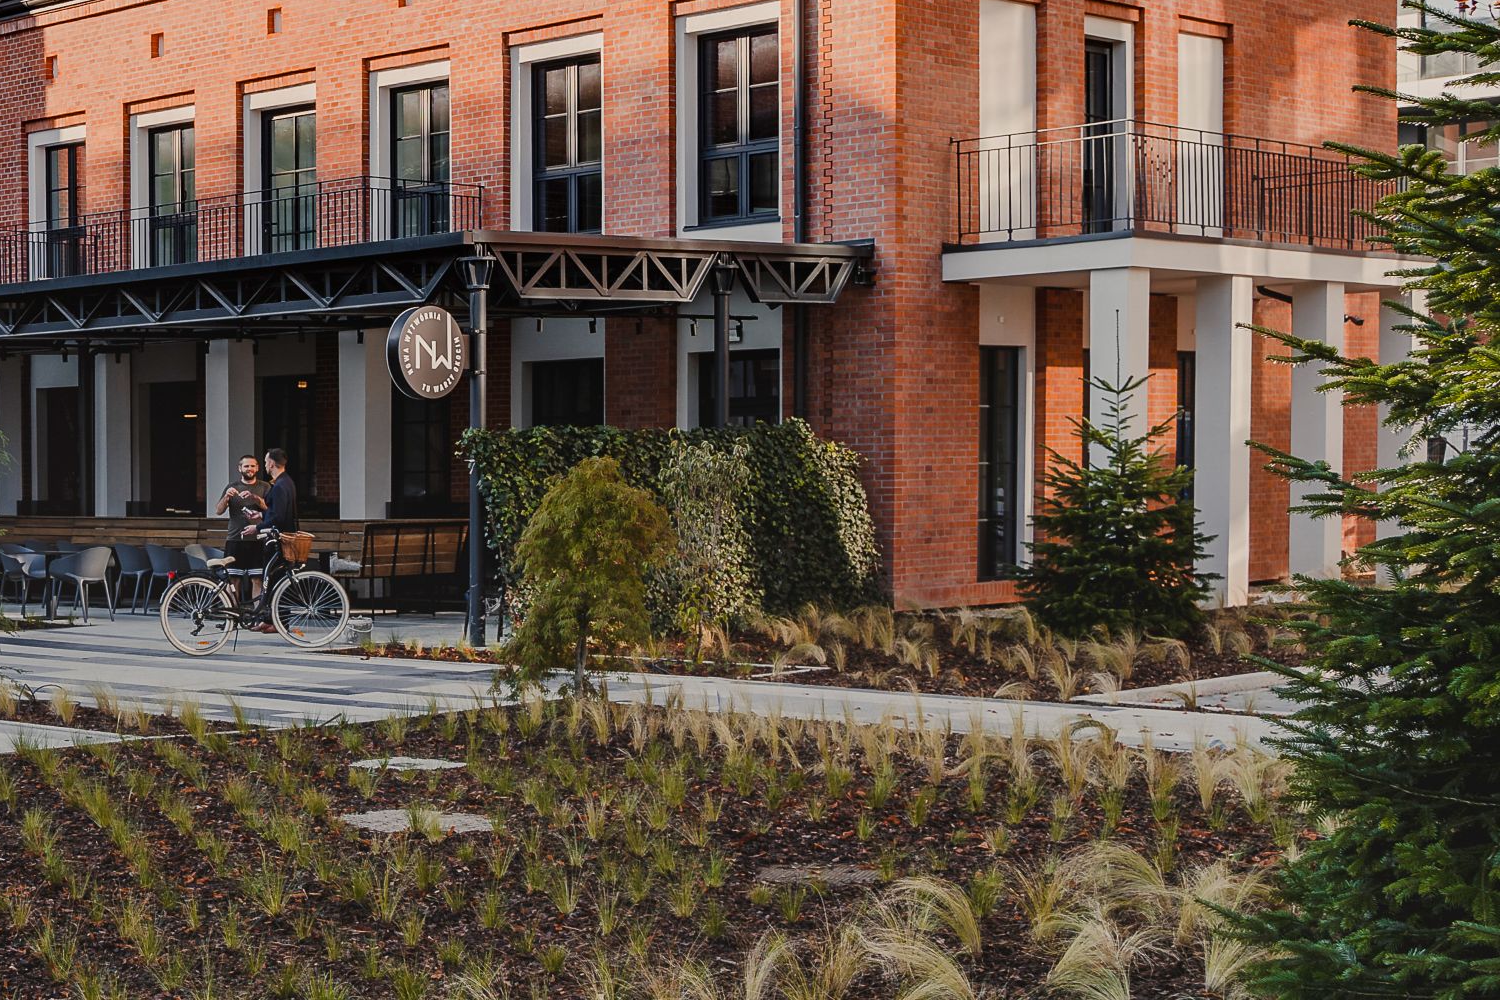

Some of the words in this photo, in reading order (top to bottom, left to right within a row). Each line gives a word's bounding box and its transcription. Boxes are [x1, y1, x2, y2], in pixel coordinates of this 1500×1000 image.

[404, 311, 441, 343] WYTWÓRNIA
[403, 347, 414, 376] NOWA
[422, 383, 431, 393] TU
[433, 374, 455, 393] WARZY
